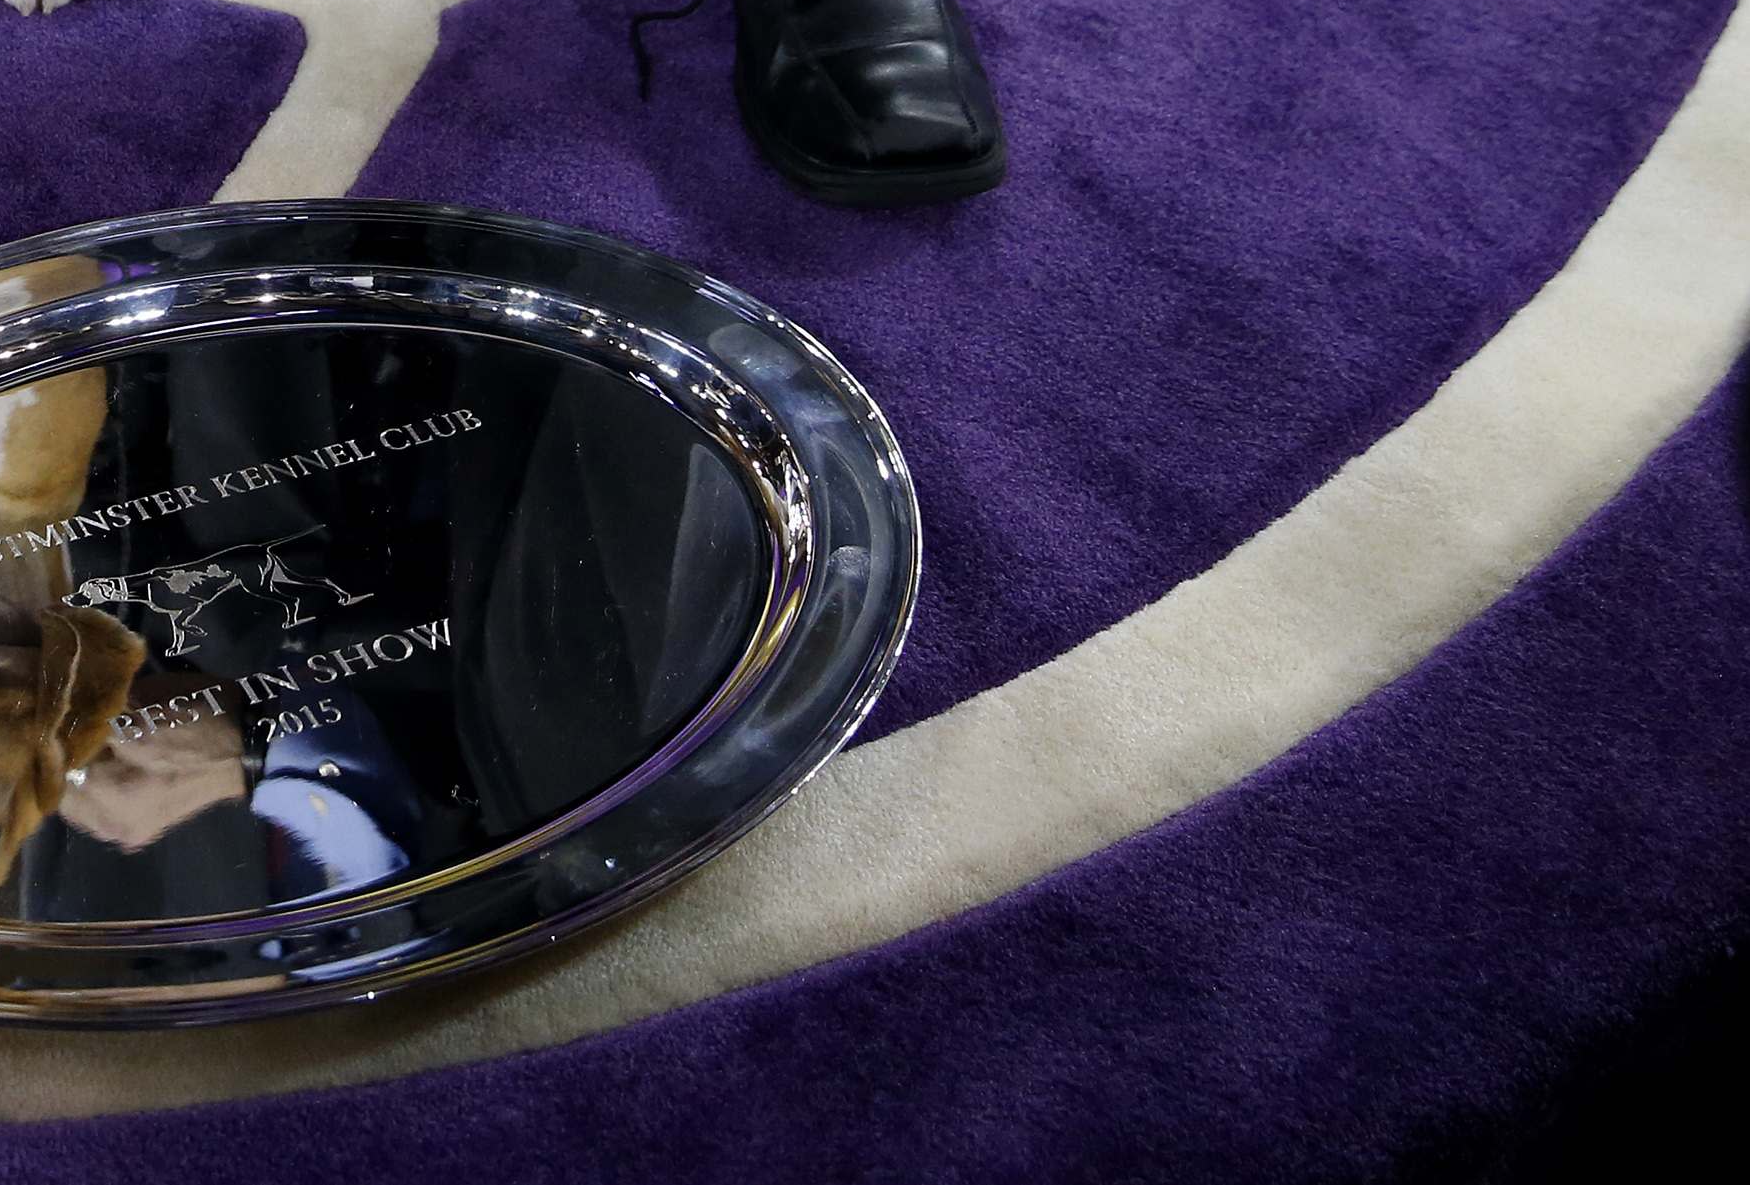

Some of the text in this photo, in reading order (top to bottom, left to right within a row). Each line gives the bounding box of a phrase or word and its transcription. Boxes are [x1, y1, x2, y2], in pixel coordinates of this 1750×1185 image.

[211, 439, 376, 498] KENNEL
[379, 408, 482, 451] CLUB
[107, 617, 452, 745] BEST IN SHOW
[257, 698, 343, 743] 2015
